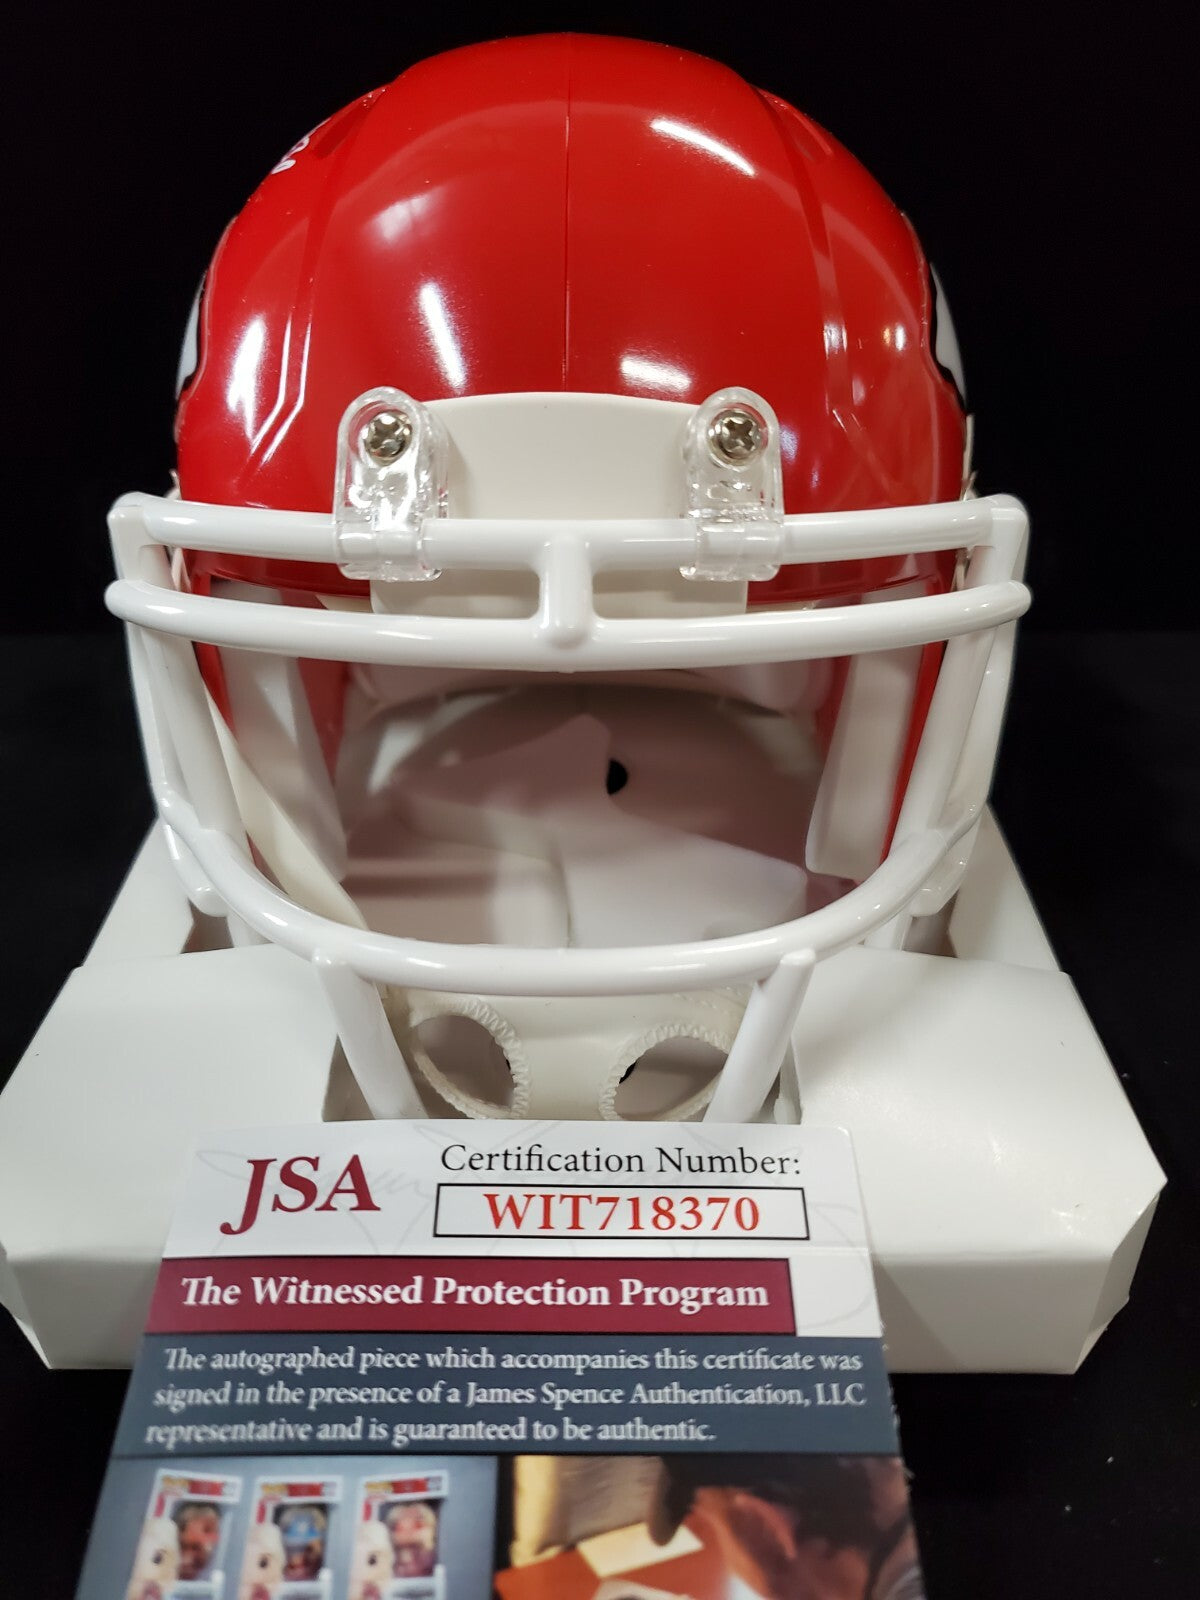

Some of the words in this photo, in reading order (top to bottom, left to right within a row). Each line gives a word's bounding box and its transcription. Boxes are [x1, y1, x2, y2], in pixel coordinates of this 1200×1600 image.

[441, 1144, 645, 1172] Certification
[655, 1147, 801, 1174] Number:
[219, 1154, 381, 1235] JSA
[482, 1193, 760, 1231] WIT718370
[181, 1275, 241, 1306] The
[250, 1275, 423, 1305] Witnessed
[431, 1276, 611, 1306] Protection
[618, 1278, 770, 1315] Program
[164, 1347, 207, 1370] The
[210, 1346, 355, 1375] autographed
[358, 1348, 421, 1375] piece
[425, 1347, 497, 1369] which
[500, 1349, 650, 1375] accompanies
[654, 1348, 698, 1370] this
[702, 1347, 816, 1370] certificate
[819, 1353, 864, 1371] was
[153, 1381, 232, 1413] signed
[235, 1382, 260, 1404] in
[265, 1380, 305, 1404] the
[307, 1386, 413, 1412] presence
[416, 1380, 447, 1403] of
[446, 1387, 462, 1403] a
[464, 1381, 537, 1408] James
[540, 1382, 625, 1411] Spence
[629, 1382, 811, 1407] Authentication,
[814, 1382, 867, 1407] LLC
[145, 1417, 314, 1450] representative
[316, 1415, 364, 1441] and
[367, 1417, 389, 1441] is
[391, 1416, 528, 1448] guaranteed
[531, 1418, 559, 1440] to
[562, 1416, 593, 1441] be
[596, 1416, 717, 1441] authentic.
